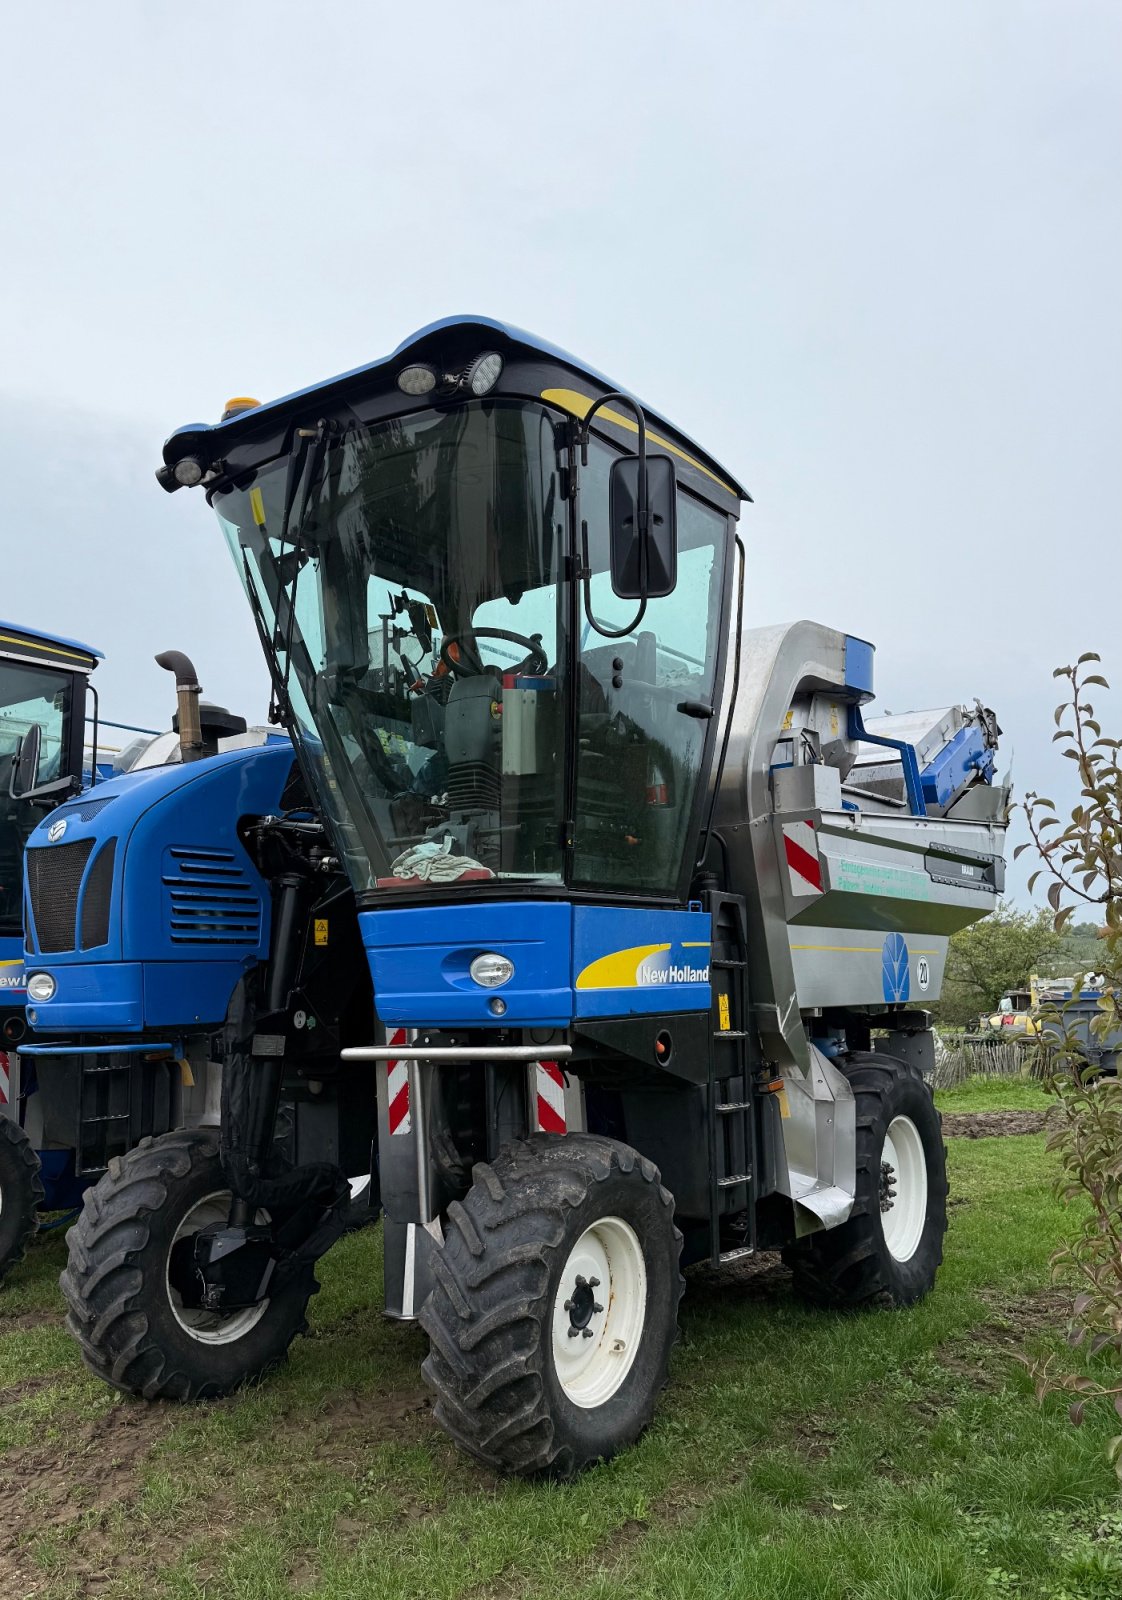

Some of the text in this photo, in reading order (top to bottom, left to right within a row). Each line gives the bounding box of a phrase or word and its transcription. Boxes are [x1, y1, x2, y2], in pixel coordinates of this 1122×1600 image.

[0, 977, 20, 986] ew
[642, 965, 709, 983] New Holland
[920, 962, 928, 984] 20
